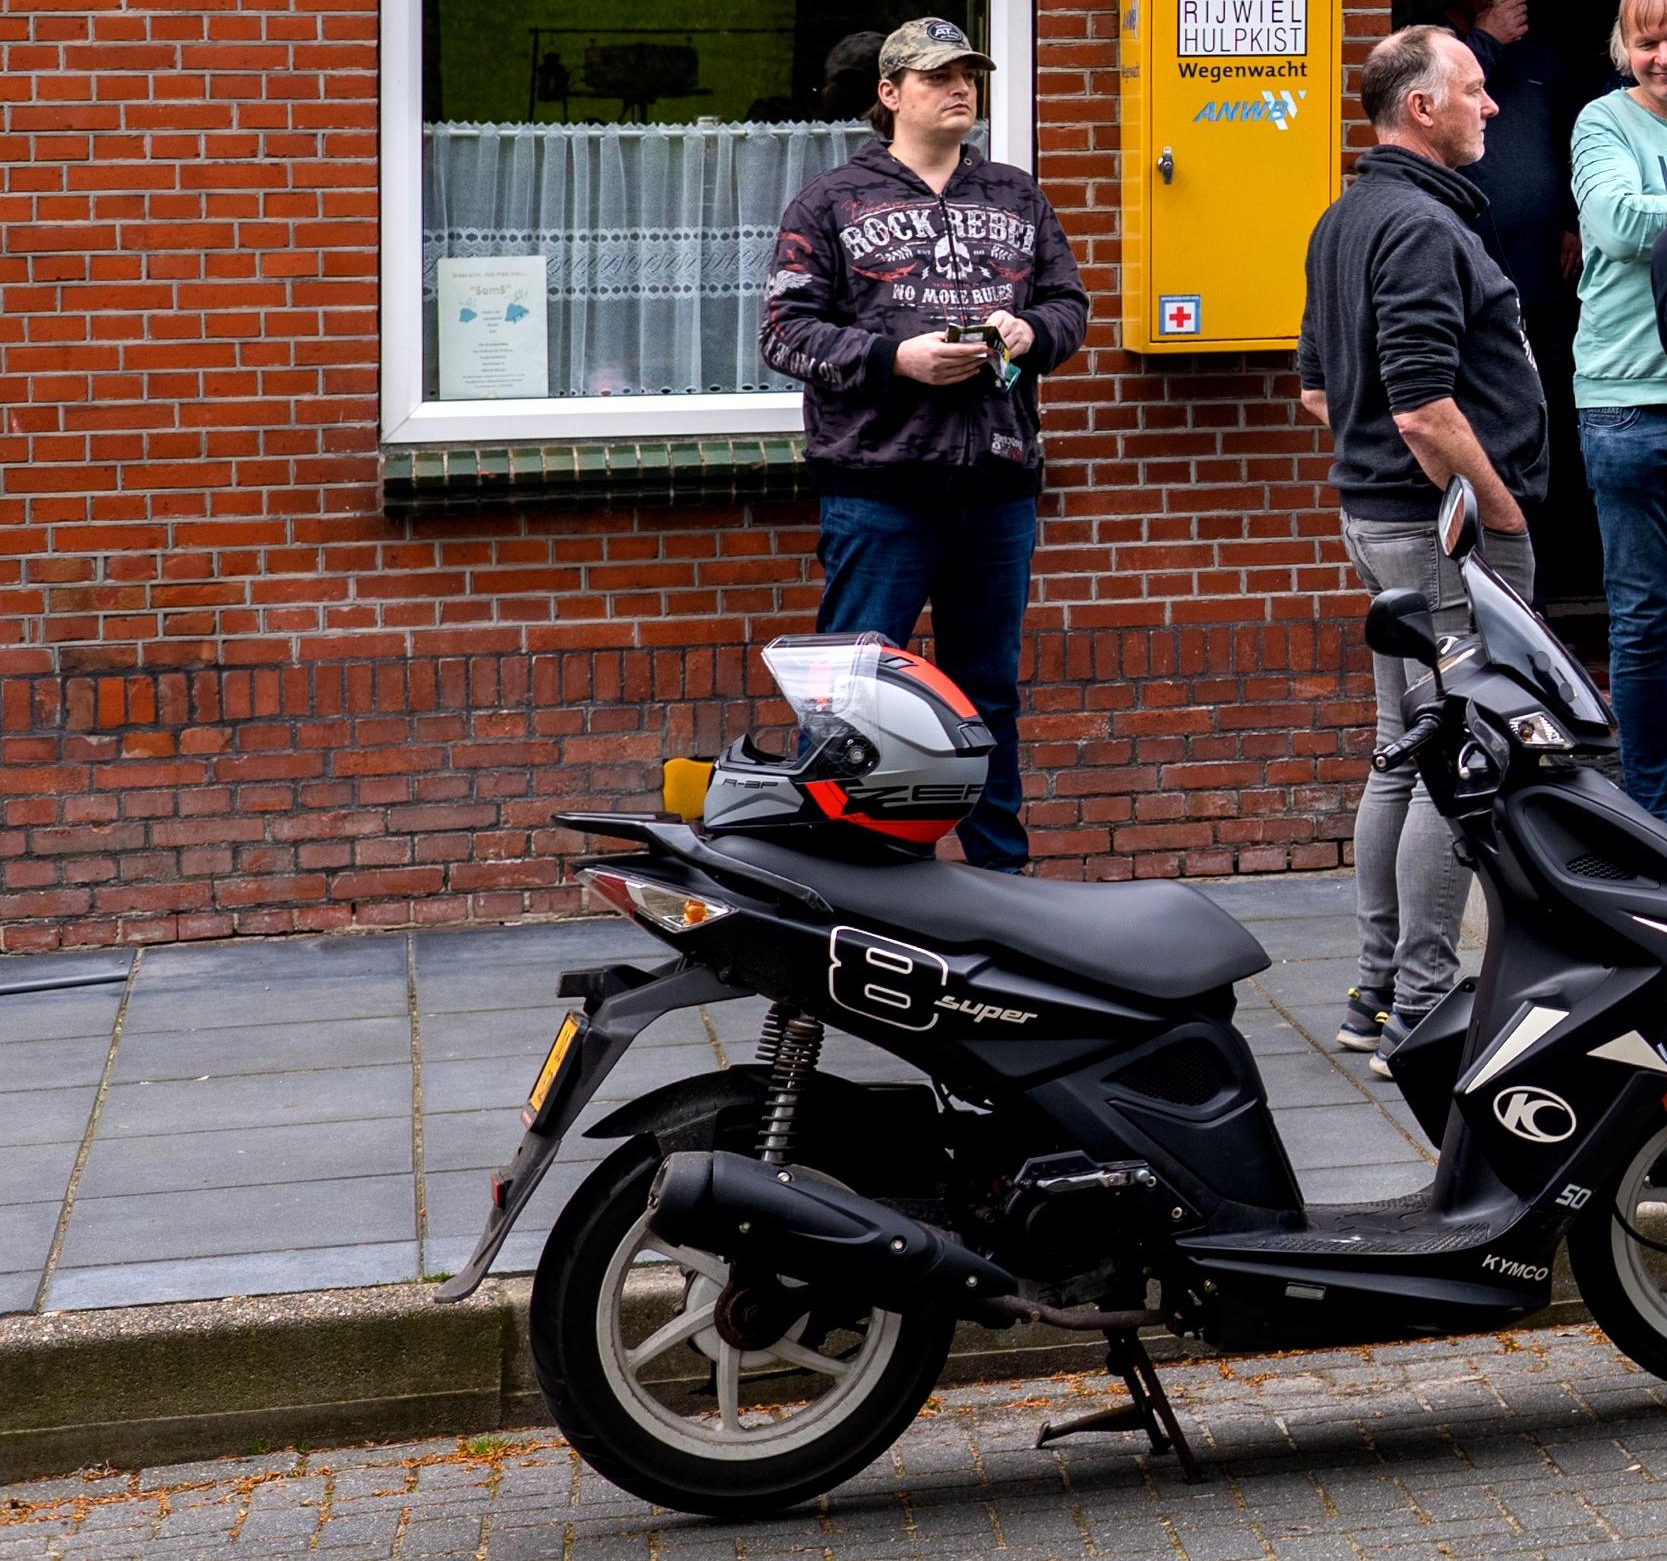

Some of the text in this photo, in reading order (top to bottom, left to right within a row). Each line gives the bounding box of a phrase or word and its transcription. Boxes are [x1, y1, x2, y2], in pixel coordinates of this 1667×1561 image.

[1184, 0, 1302, 24] RIJWIEL
[1184, 27, 1302, 52] HULPKIST
[1178, 61, 1308, 83] Wegenwacht
[1192, 99, 1289, 123] ANWB
[838, 208, 938, 260] ROCK
[892, 282, 1014, 306] NO MORE RULES
[935, 994, 1039, 1027] super
[1555, 1182, 1593, 1210] 50
[1481, 1253, 1549, 1282] KYMCO
